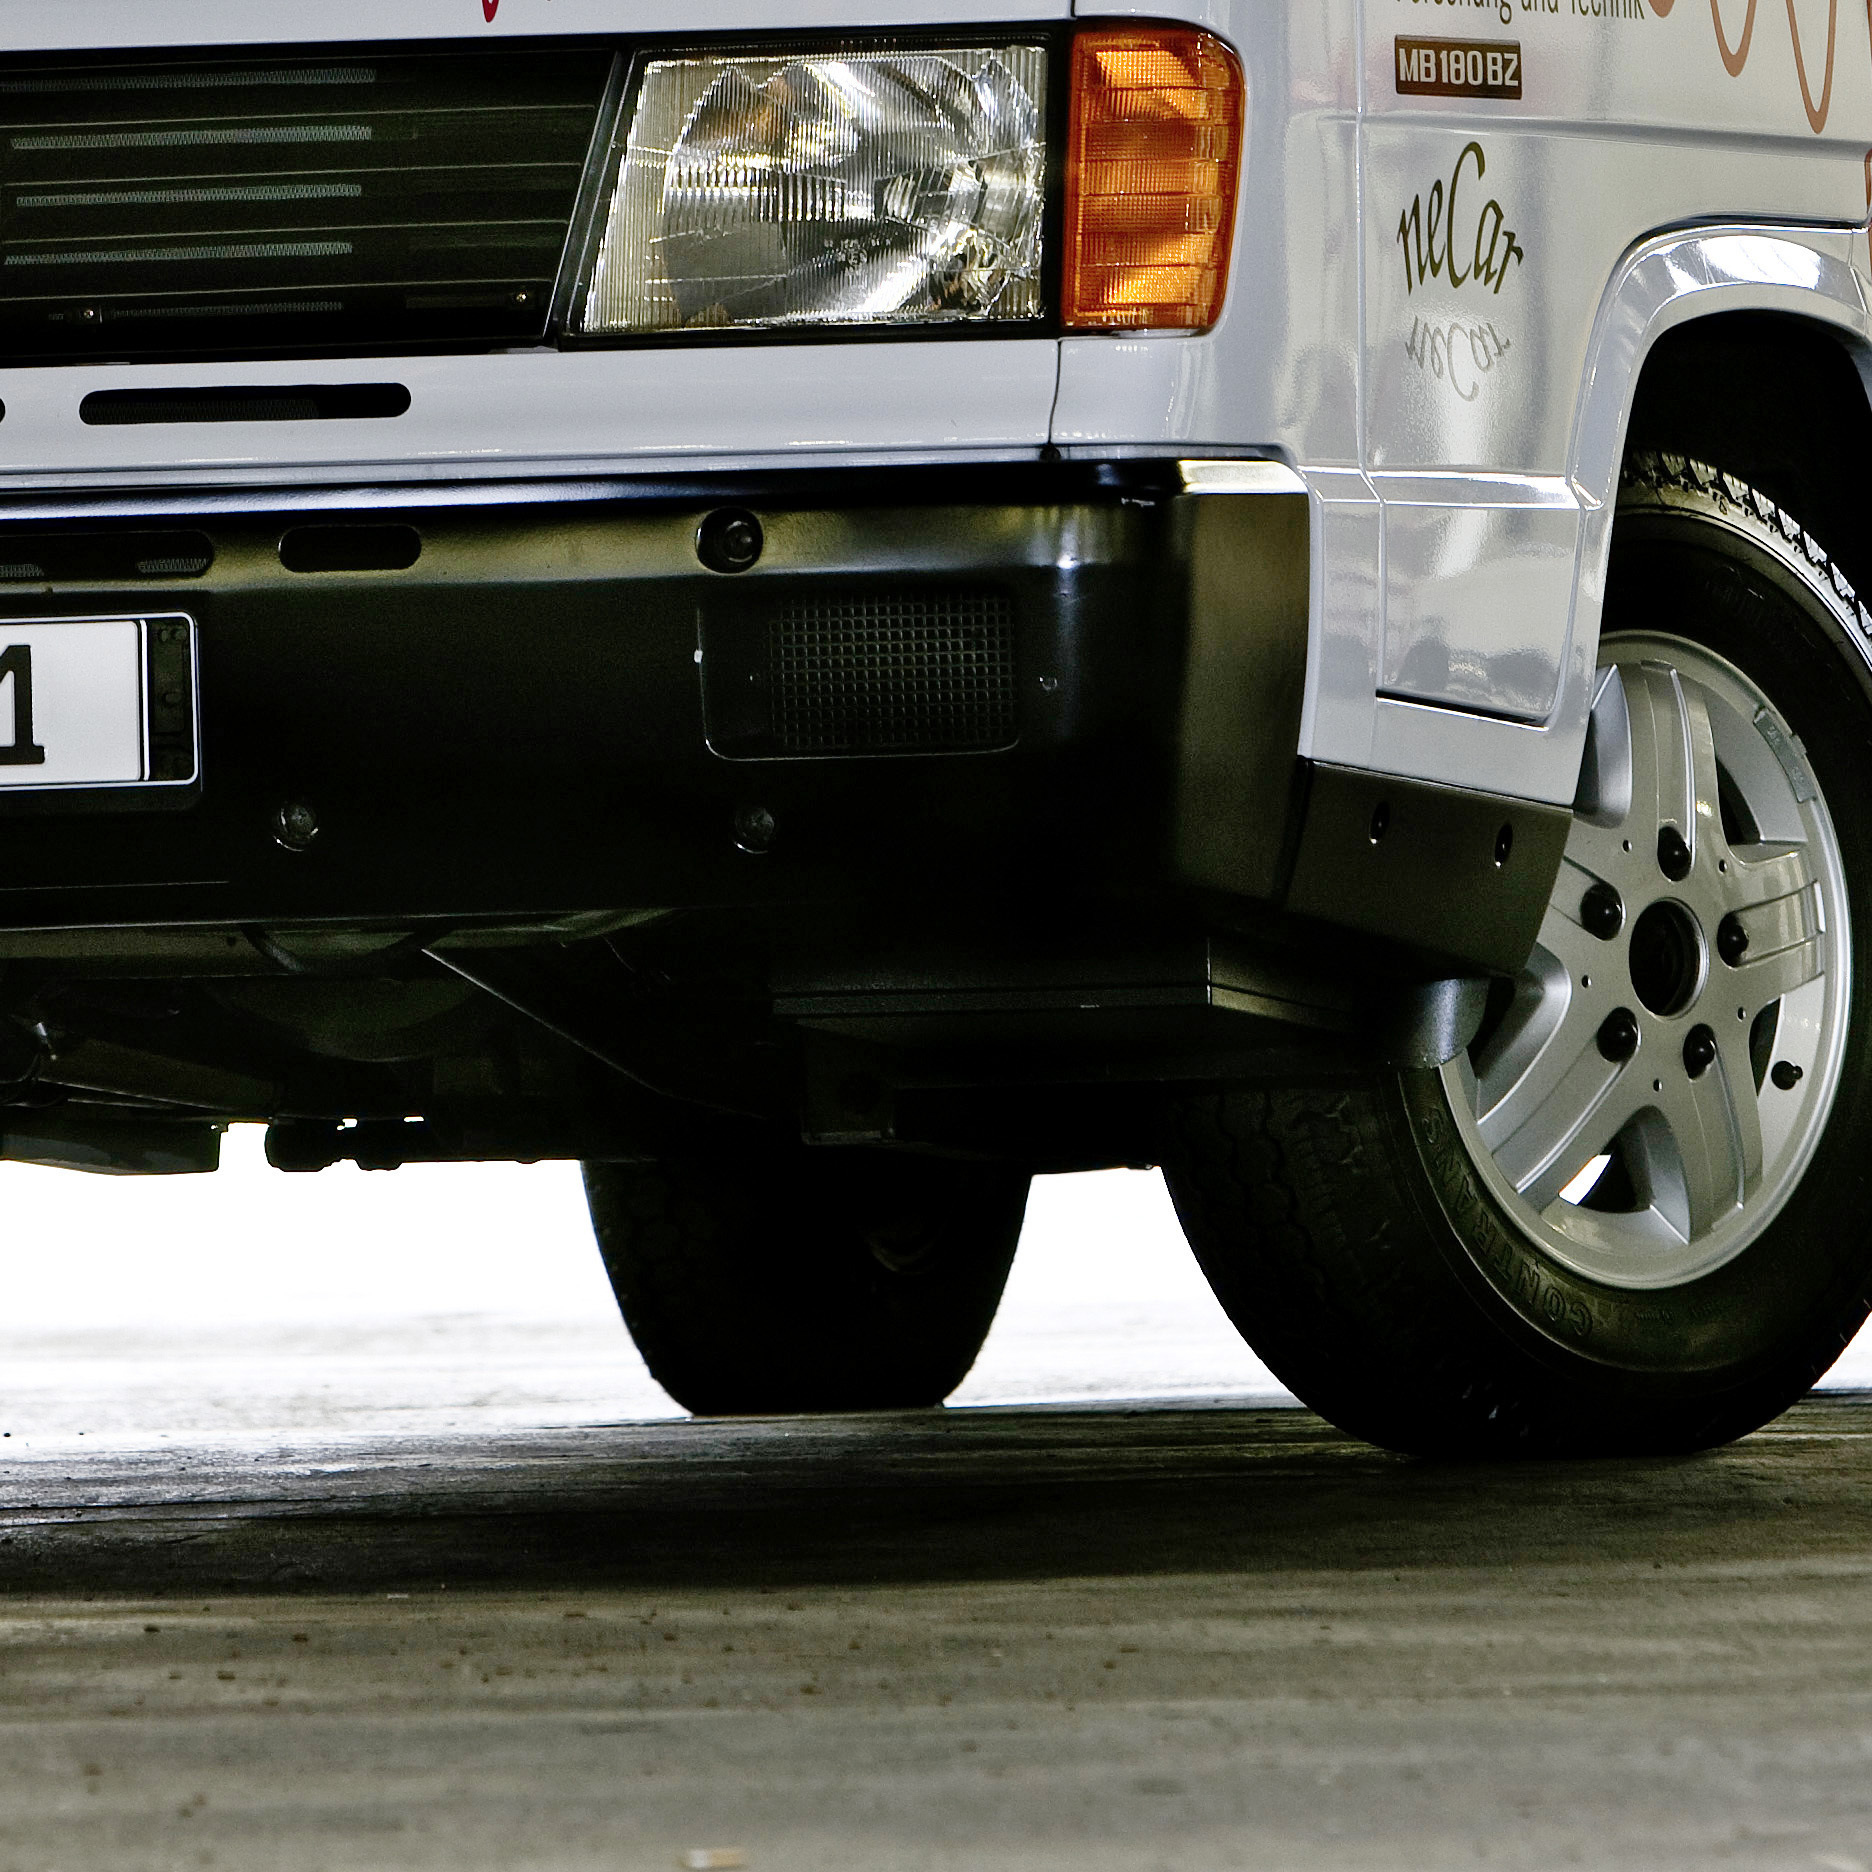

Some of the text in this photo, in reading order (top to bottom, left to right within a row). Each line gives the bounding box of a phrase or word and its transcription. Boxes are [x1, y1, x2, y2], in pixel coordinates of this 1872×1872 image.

[1398, 47, 1519, 87] MB 180 BZ
[1396, 141, 1524, 296] neCar
